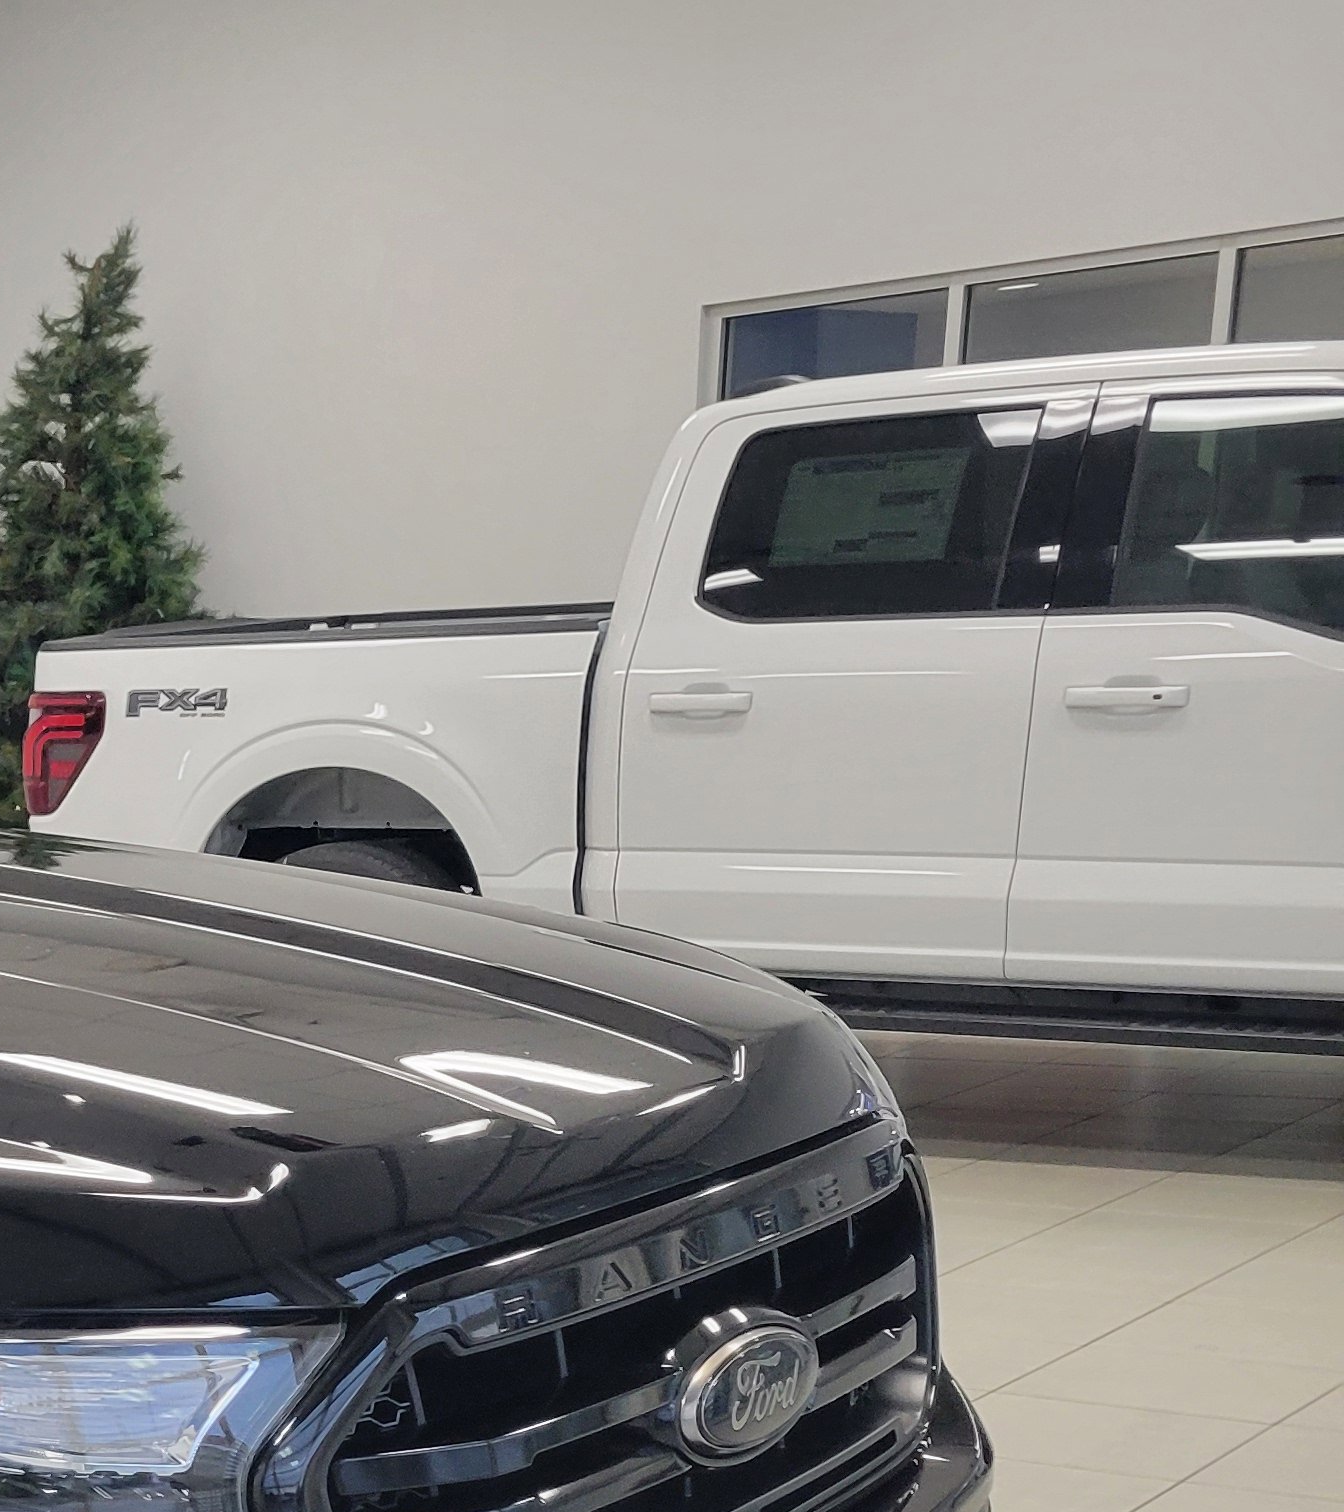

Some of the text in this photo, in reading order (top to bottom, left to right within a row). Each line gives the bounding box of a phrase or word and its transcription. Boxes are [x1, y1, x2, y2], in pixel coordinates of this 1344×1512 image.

[125, 687, 229, 717] FX4
[497, 1146, 902, 1331] RANGER
[731, 1351, 800, 1431] Ford
